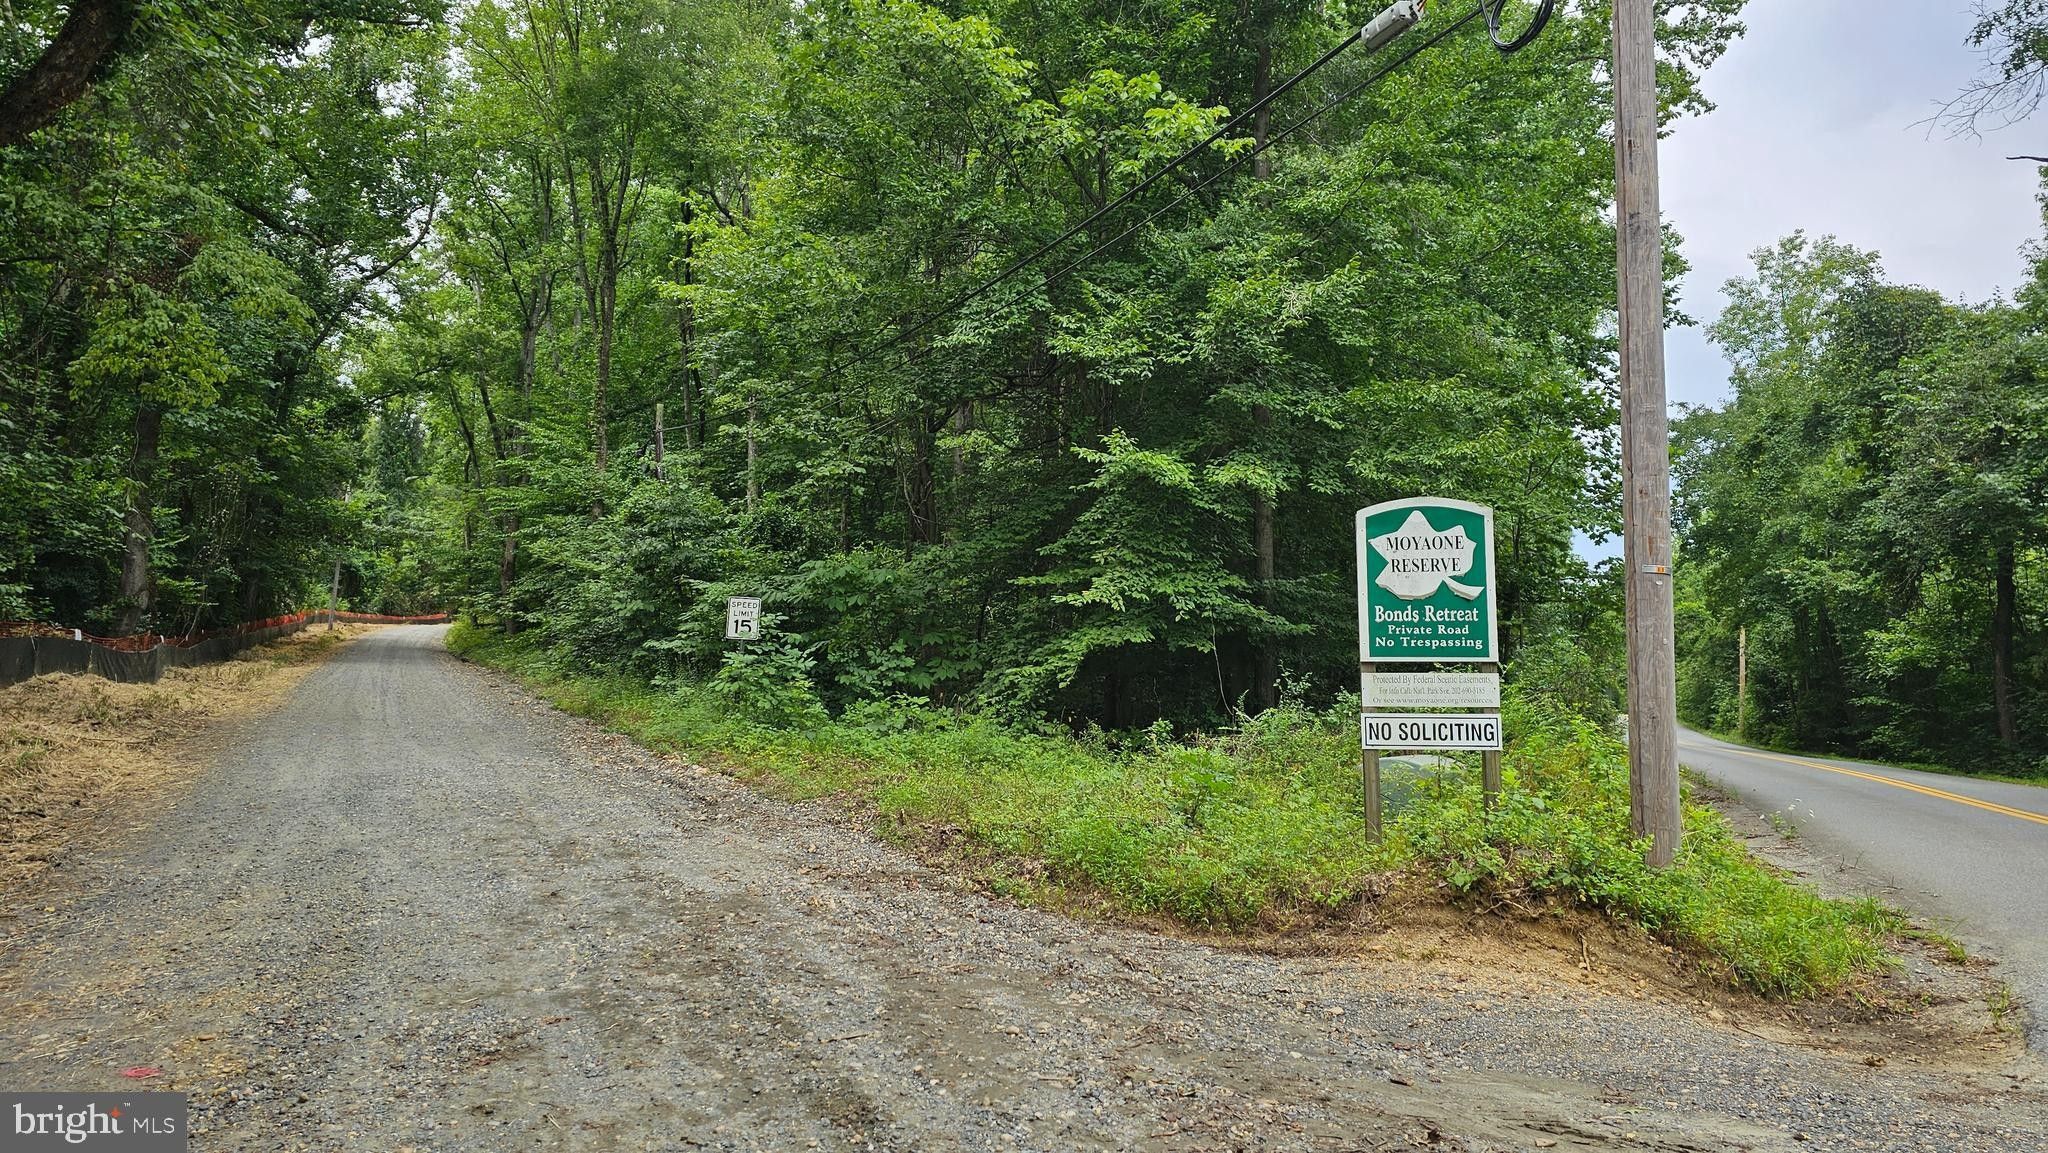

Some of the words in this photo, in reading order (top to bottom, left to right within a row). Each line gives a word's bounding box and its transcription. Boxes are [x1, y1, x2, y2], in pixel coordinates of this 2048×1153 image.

[1386, 535, 1464, 551] MOYAONE
[1391, 557, 1461, 573] RESERVE
[731, 601, 758, 609] SPEED
[1374, 605, 1419, 623] Bonds
[1424, 605, 1479, 622] Retreat
[734, 619, 752, 634] 15
[1388, 624, 1433, 635] Private
[1437, 624, 1469, 635] Road
[1375, 636, 1395, 647] No
[1400, 636, 1483, 650] Trespassing
[1372, 675, 1401, 684] Protected
[1402, 675, 1411, 686] By
[1413, 675, 1436, 684] Federal
[1368, 722, 1392, 741] NO
[1398, 722, 1495, 742] SOLICITING
